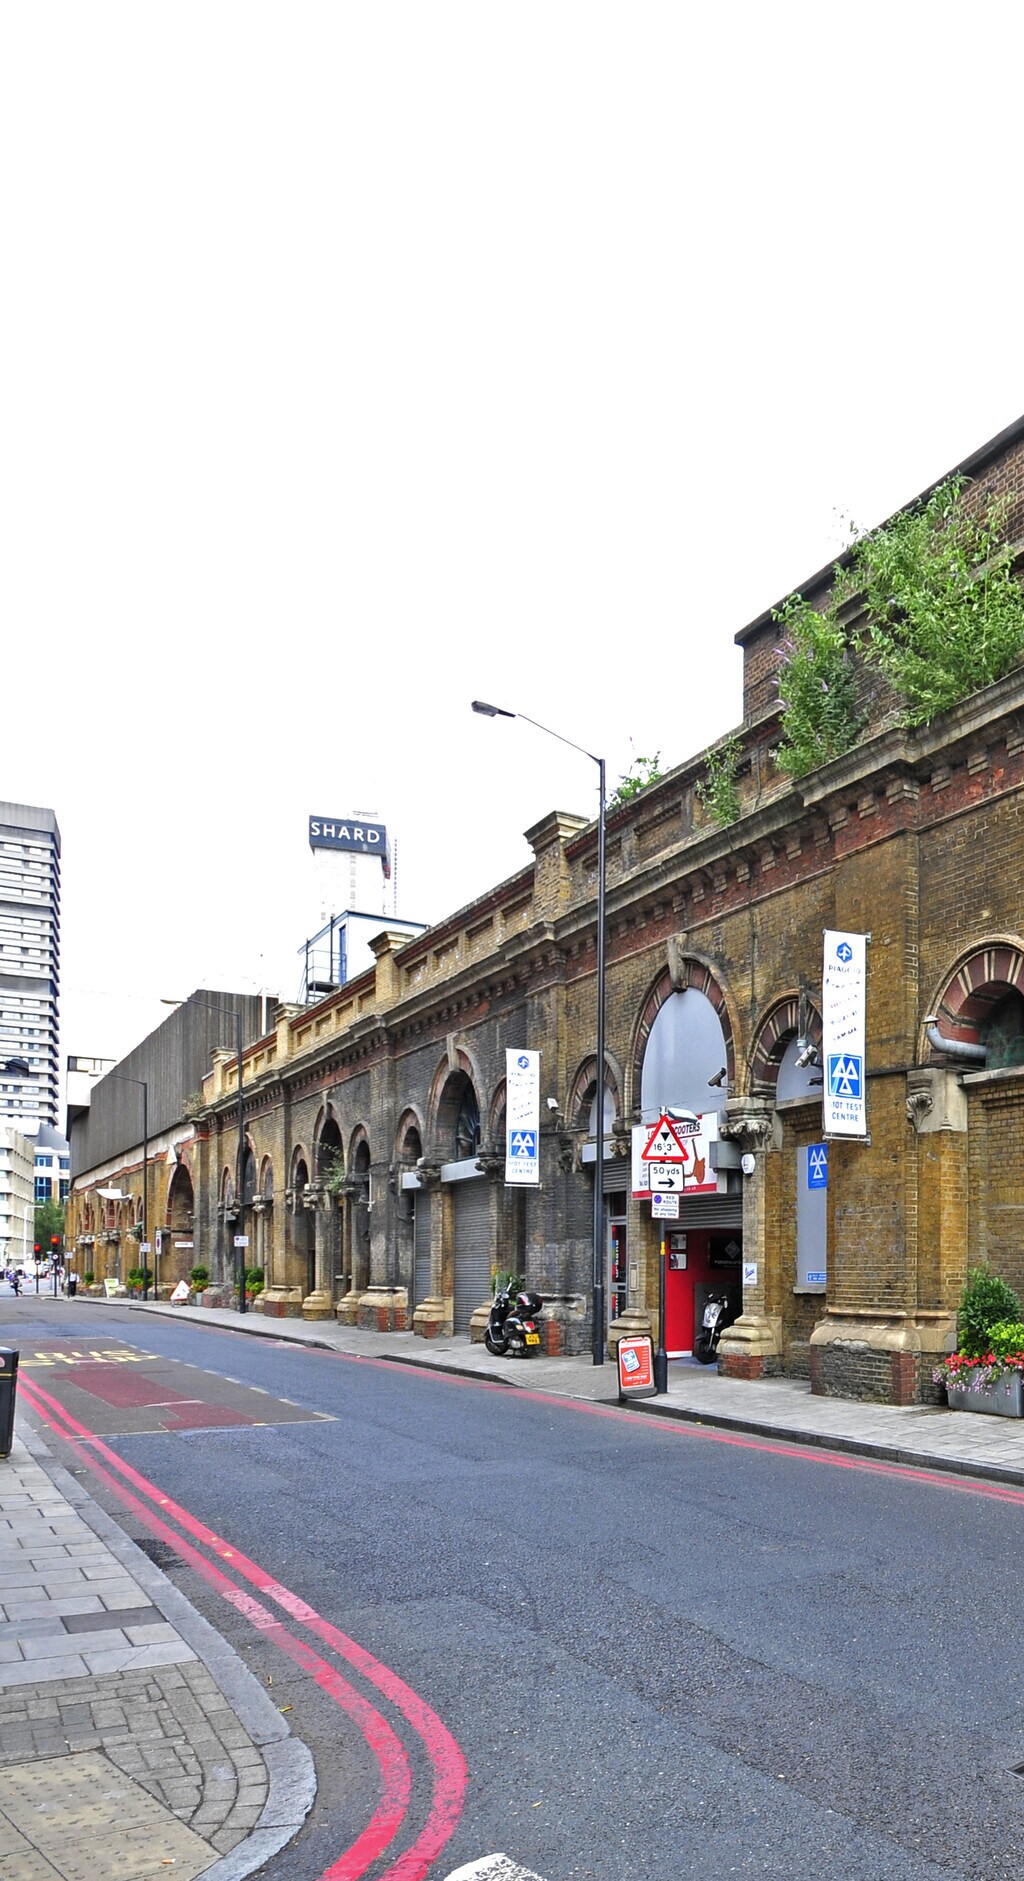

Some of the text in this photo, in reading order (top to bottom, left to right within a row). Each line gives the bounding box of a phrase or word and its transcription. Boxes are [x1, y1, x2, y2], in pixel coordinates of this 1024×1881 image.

[311, 822, 380, 843] SHARD
[846, 1102, 862, 1111] TEST
[832, 1112, 859, 1122] CENTRE
[675, 1122, 700, 1136] COOTERS
[667, 1168, 680, 1176] yds
